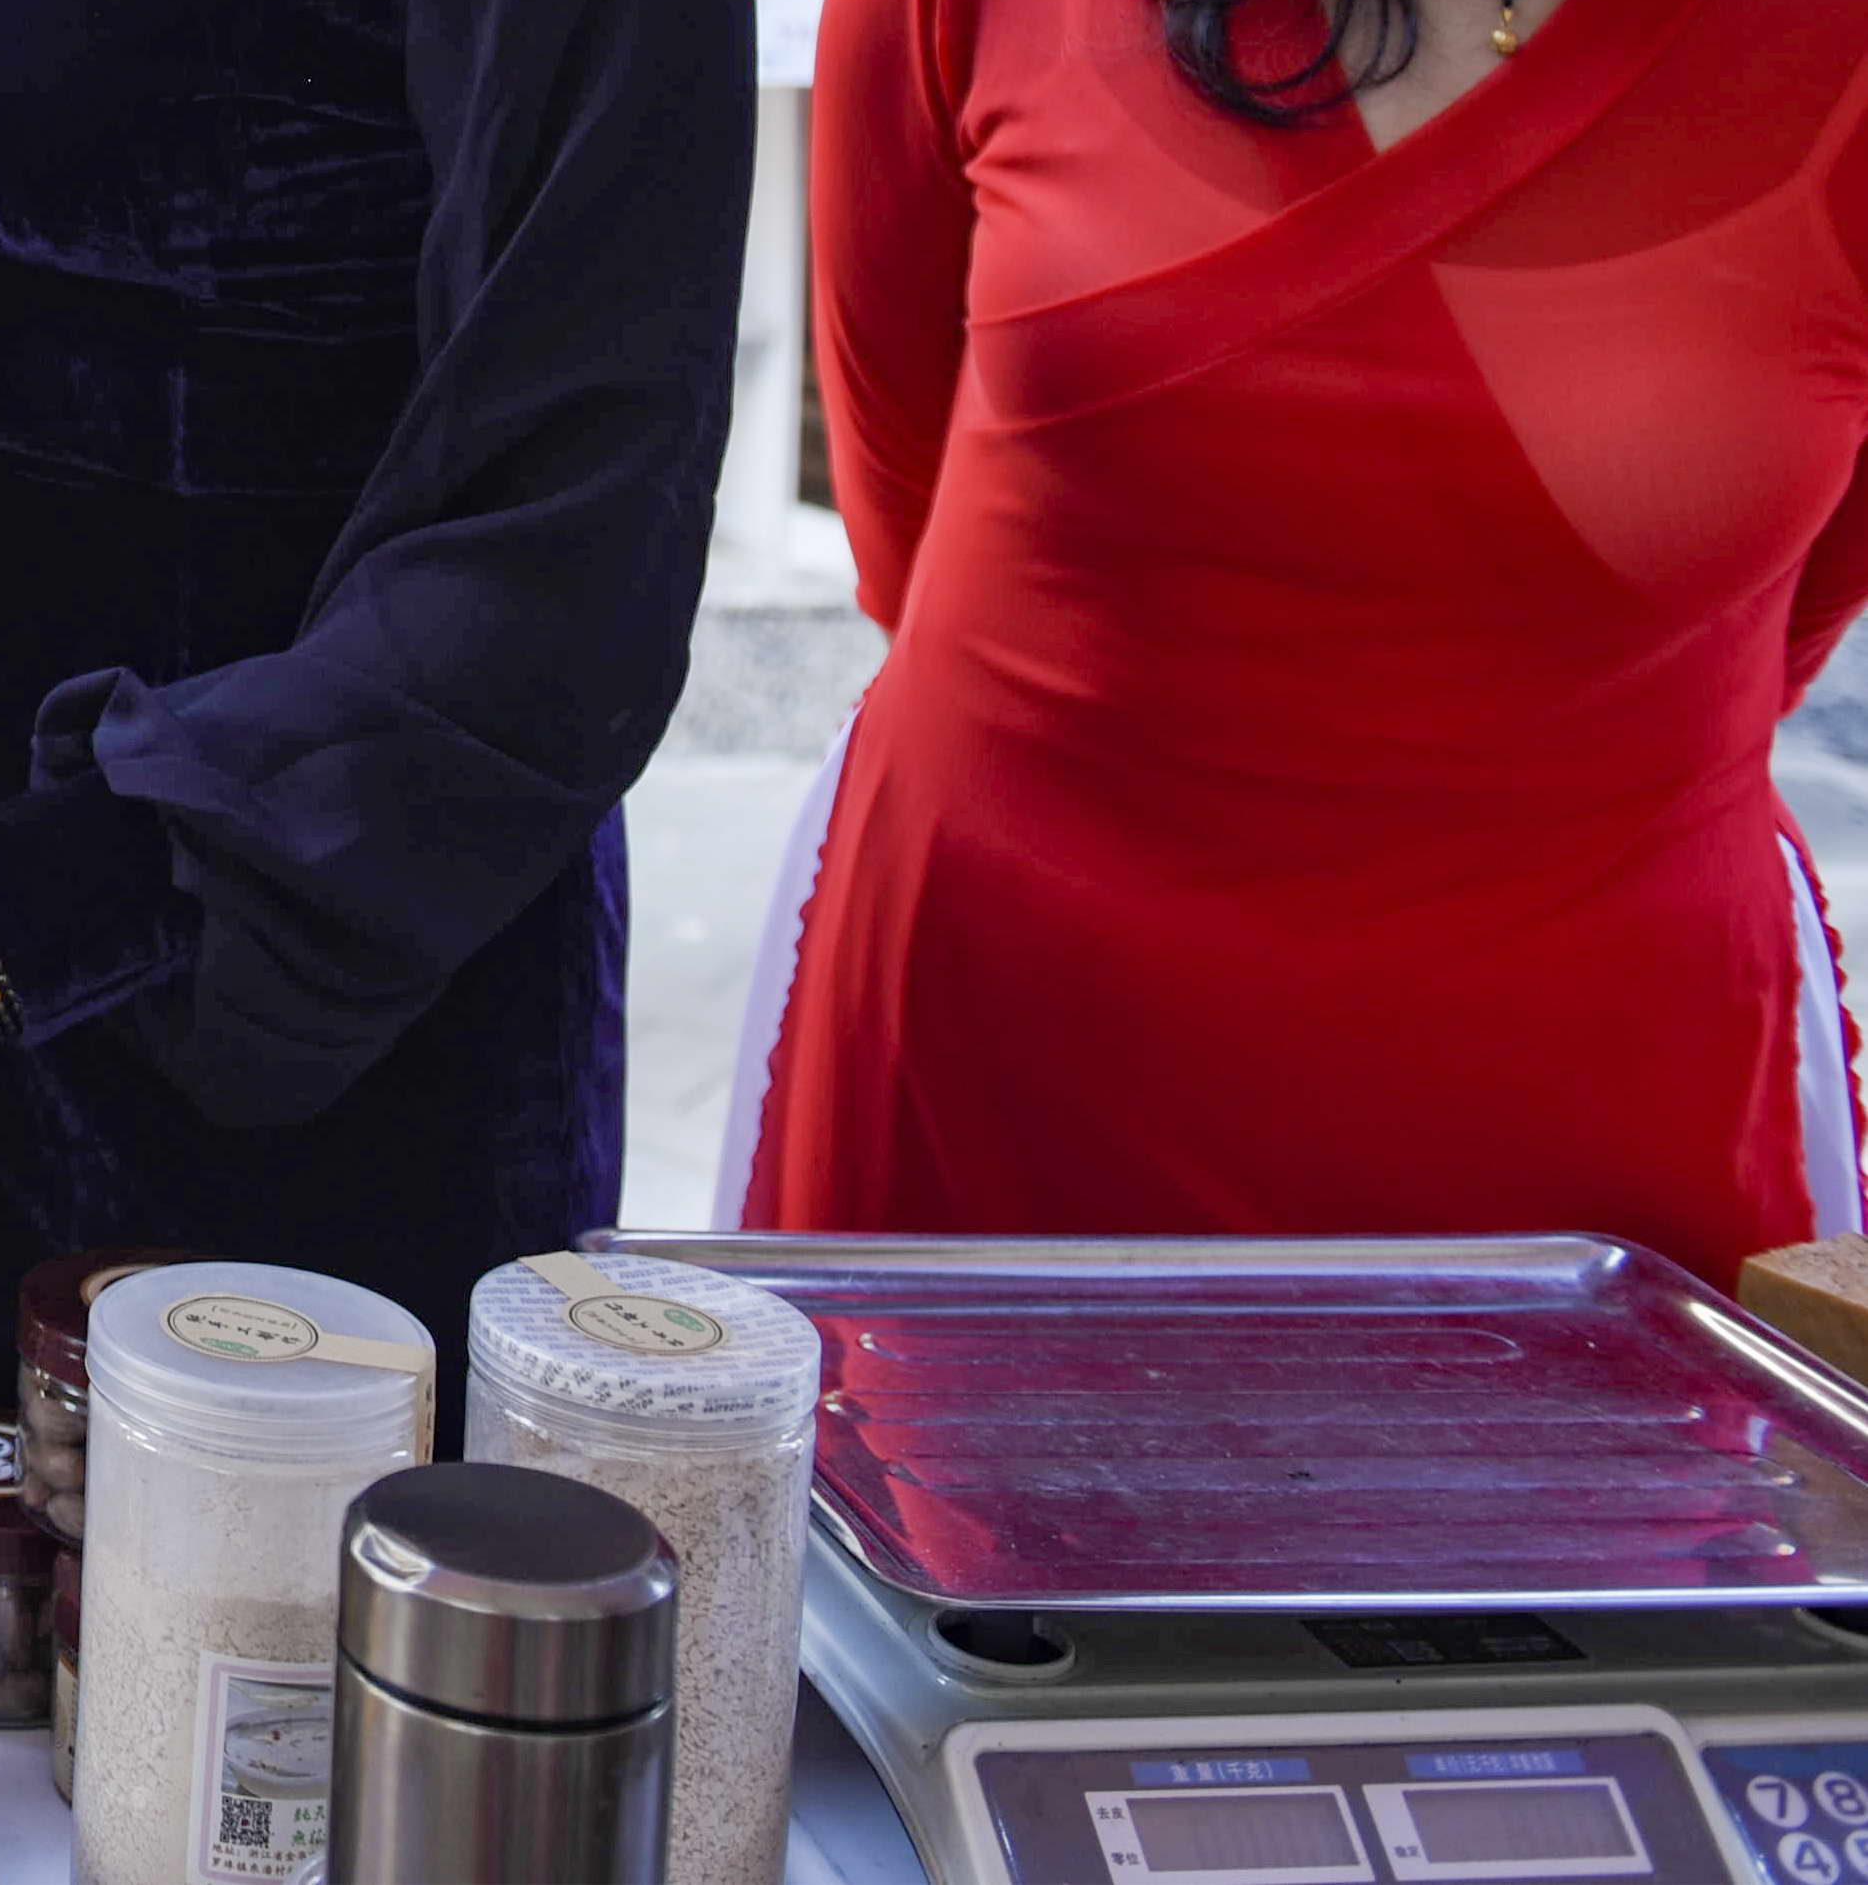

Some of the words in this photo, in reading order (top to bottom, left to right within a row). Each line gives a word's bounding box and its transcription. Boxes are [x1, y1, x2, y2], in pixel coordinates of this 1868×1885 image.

[1754, 1781, 1788, 1820] 7
[1824, 1778, 1867, 1816] 8
[1795, 1840, 1832, 1879] 4
